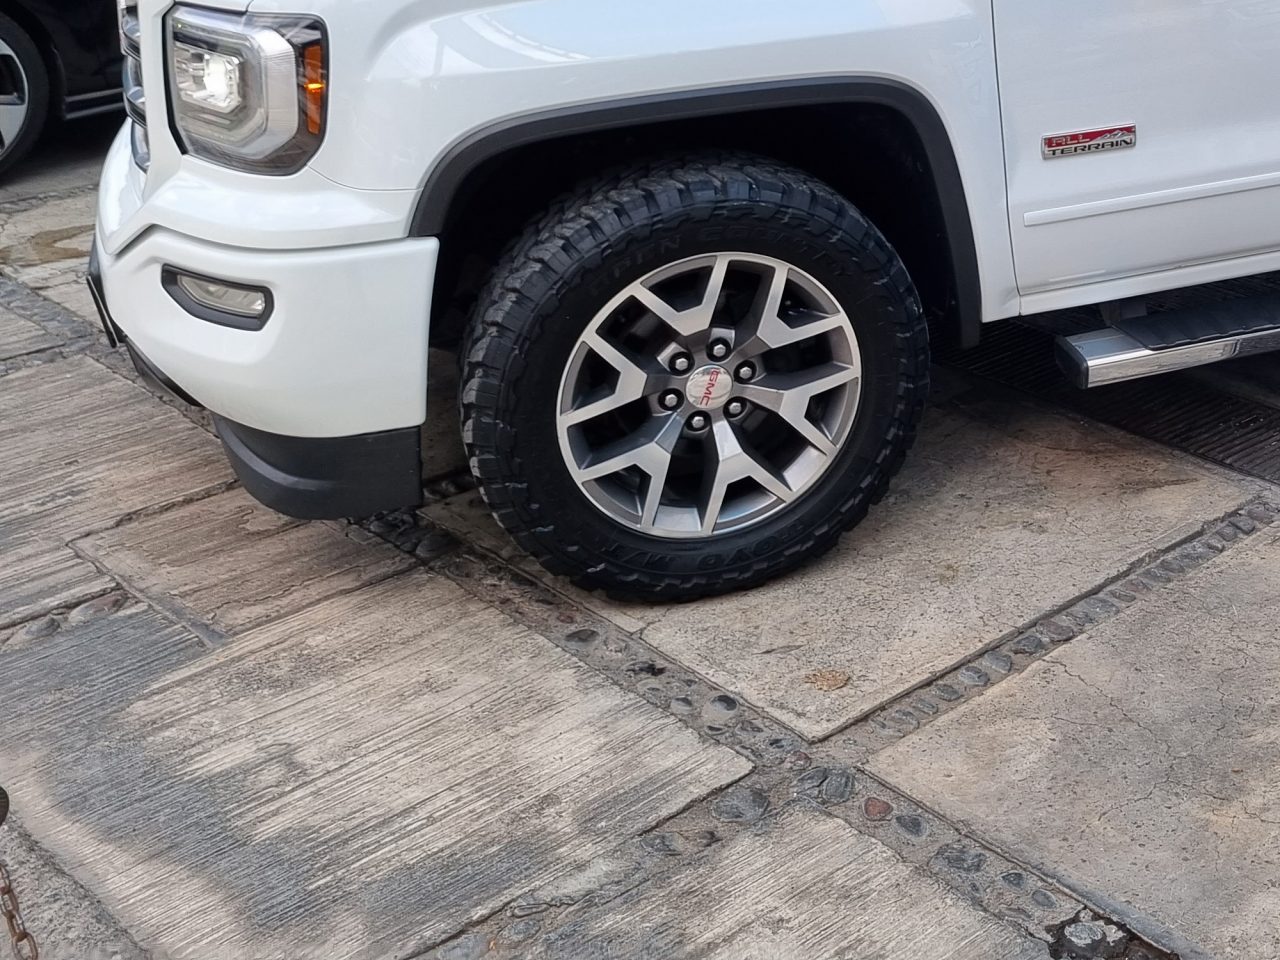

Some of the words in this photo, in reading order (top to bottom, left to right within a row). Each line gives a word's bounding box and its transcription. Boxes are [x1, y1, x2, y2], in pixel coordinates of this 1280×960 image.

[1047, 138, 1133, 156] TERRAIN
[1052, 134, 1090, 146] ALL
[700, 369, 720, 407] GMC
